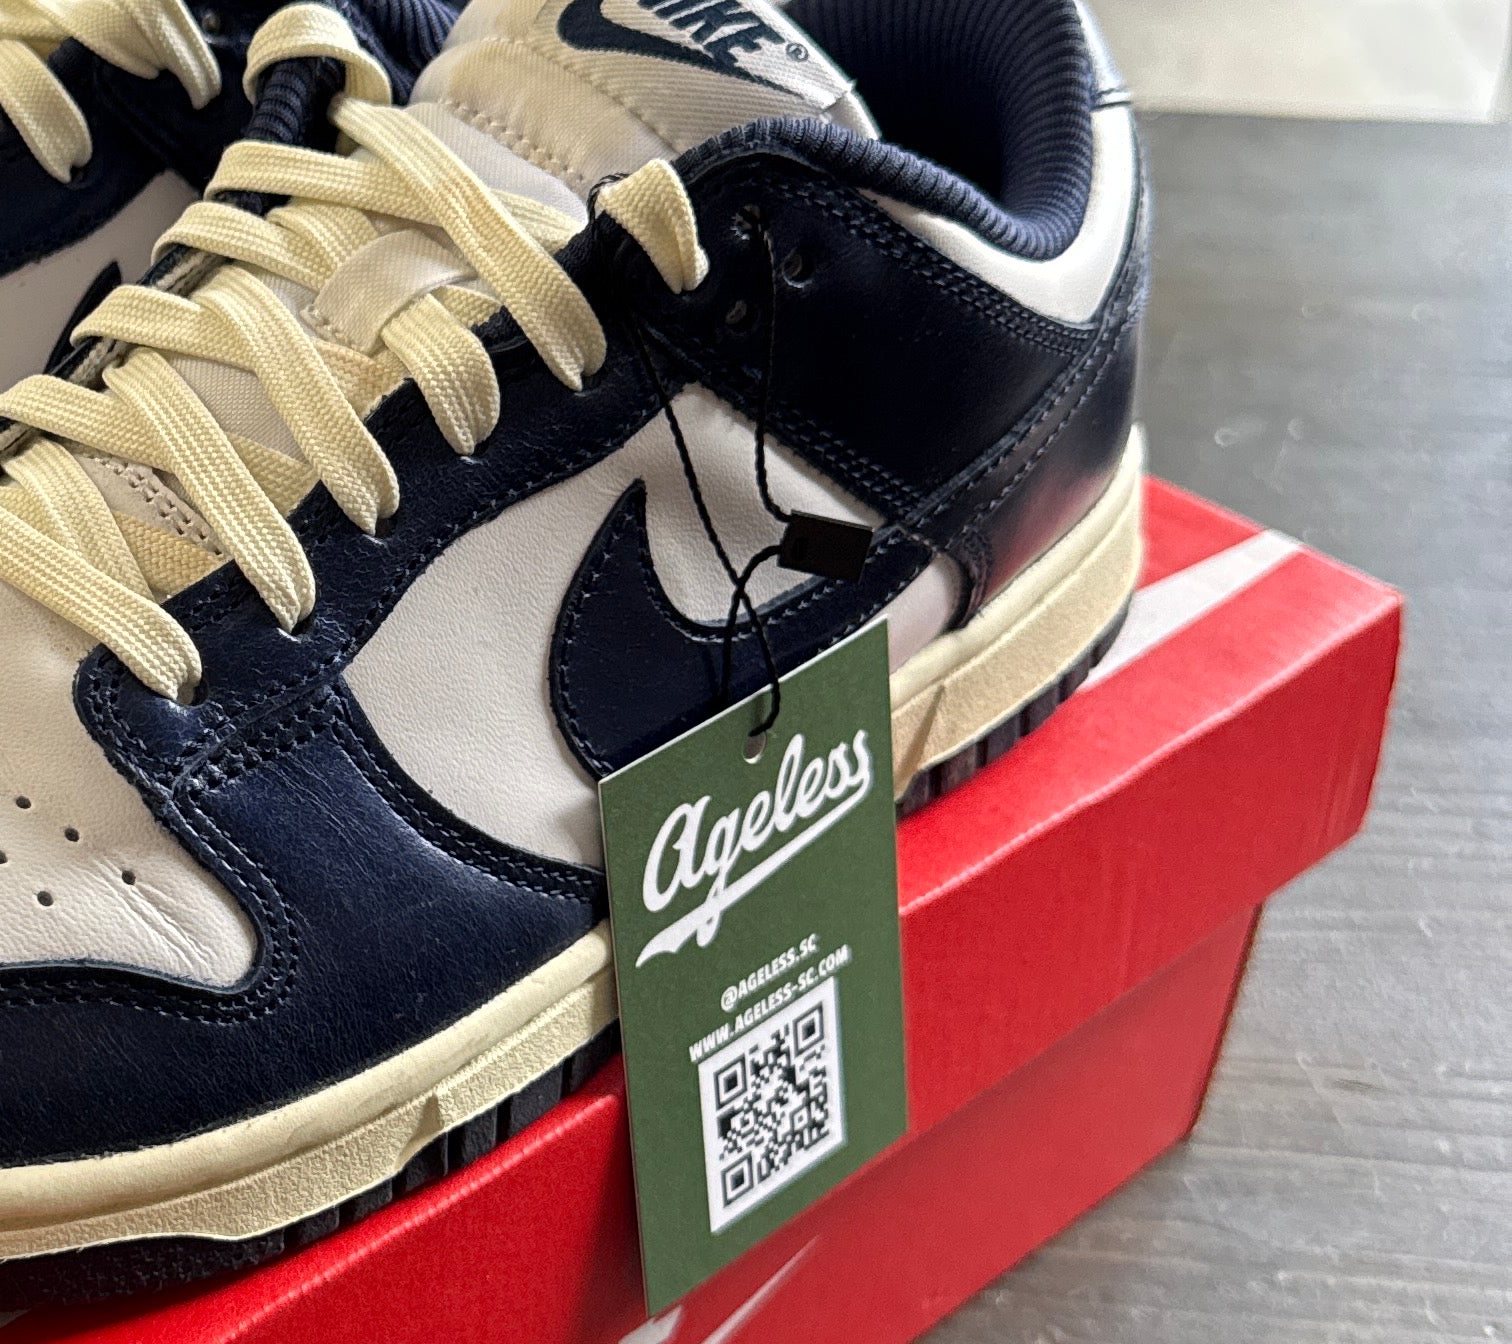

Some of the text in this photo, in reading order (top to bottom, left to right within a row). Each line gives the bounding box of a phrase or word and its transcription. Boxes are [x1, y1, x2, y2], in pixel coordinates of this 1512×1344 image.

[641, 729, 874, 948] Ageless
[689, 944, 851, 1063] WWW.AGELESS-SC.COM
[721, 933, 819, 1012] @AGELESS.SC
